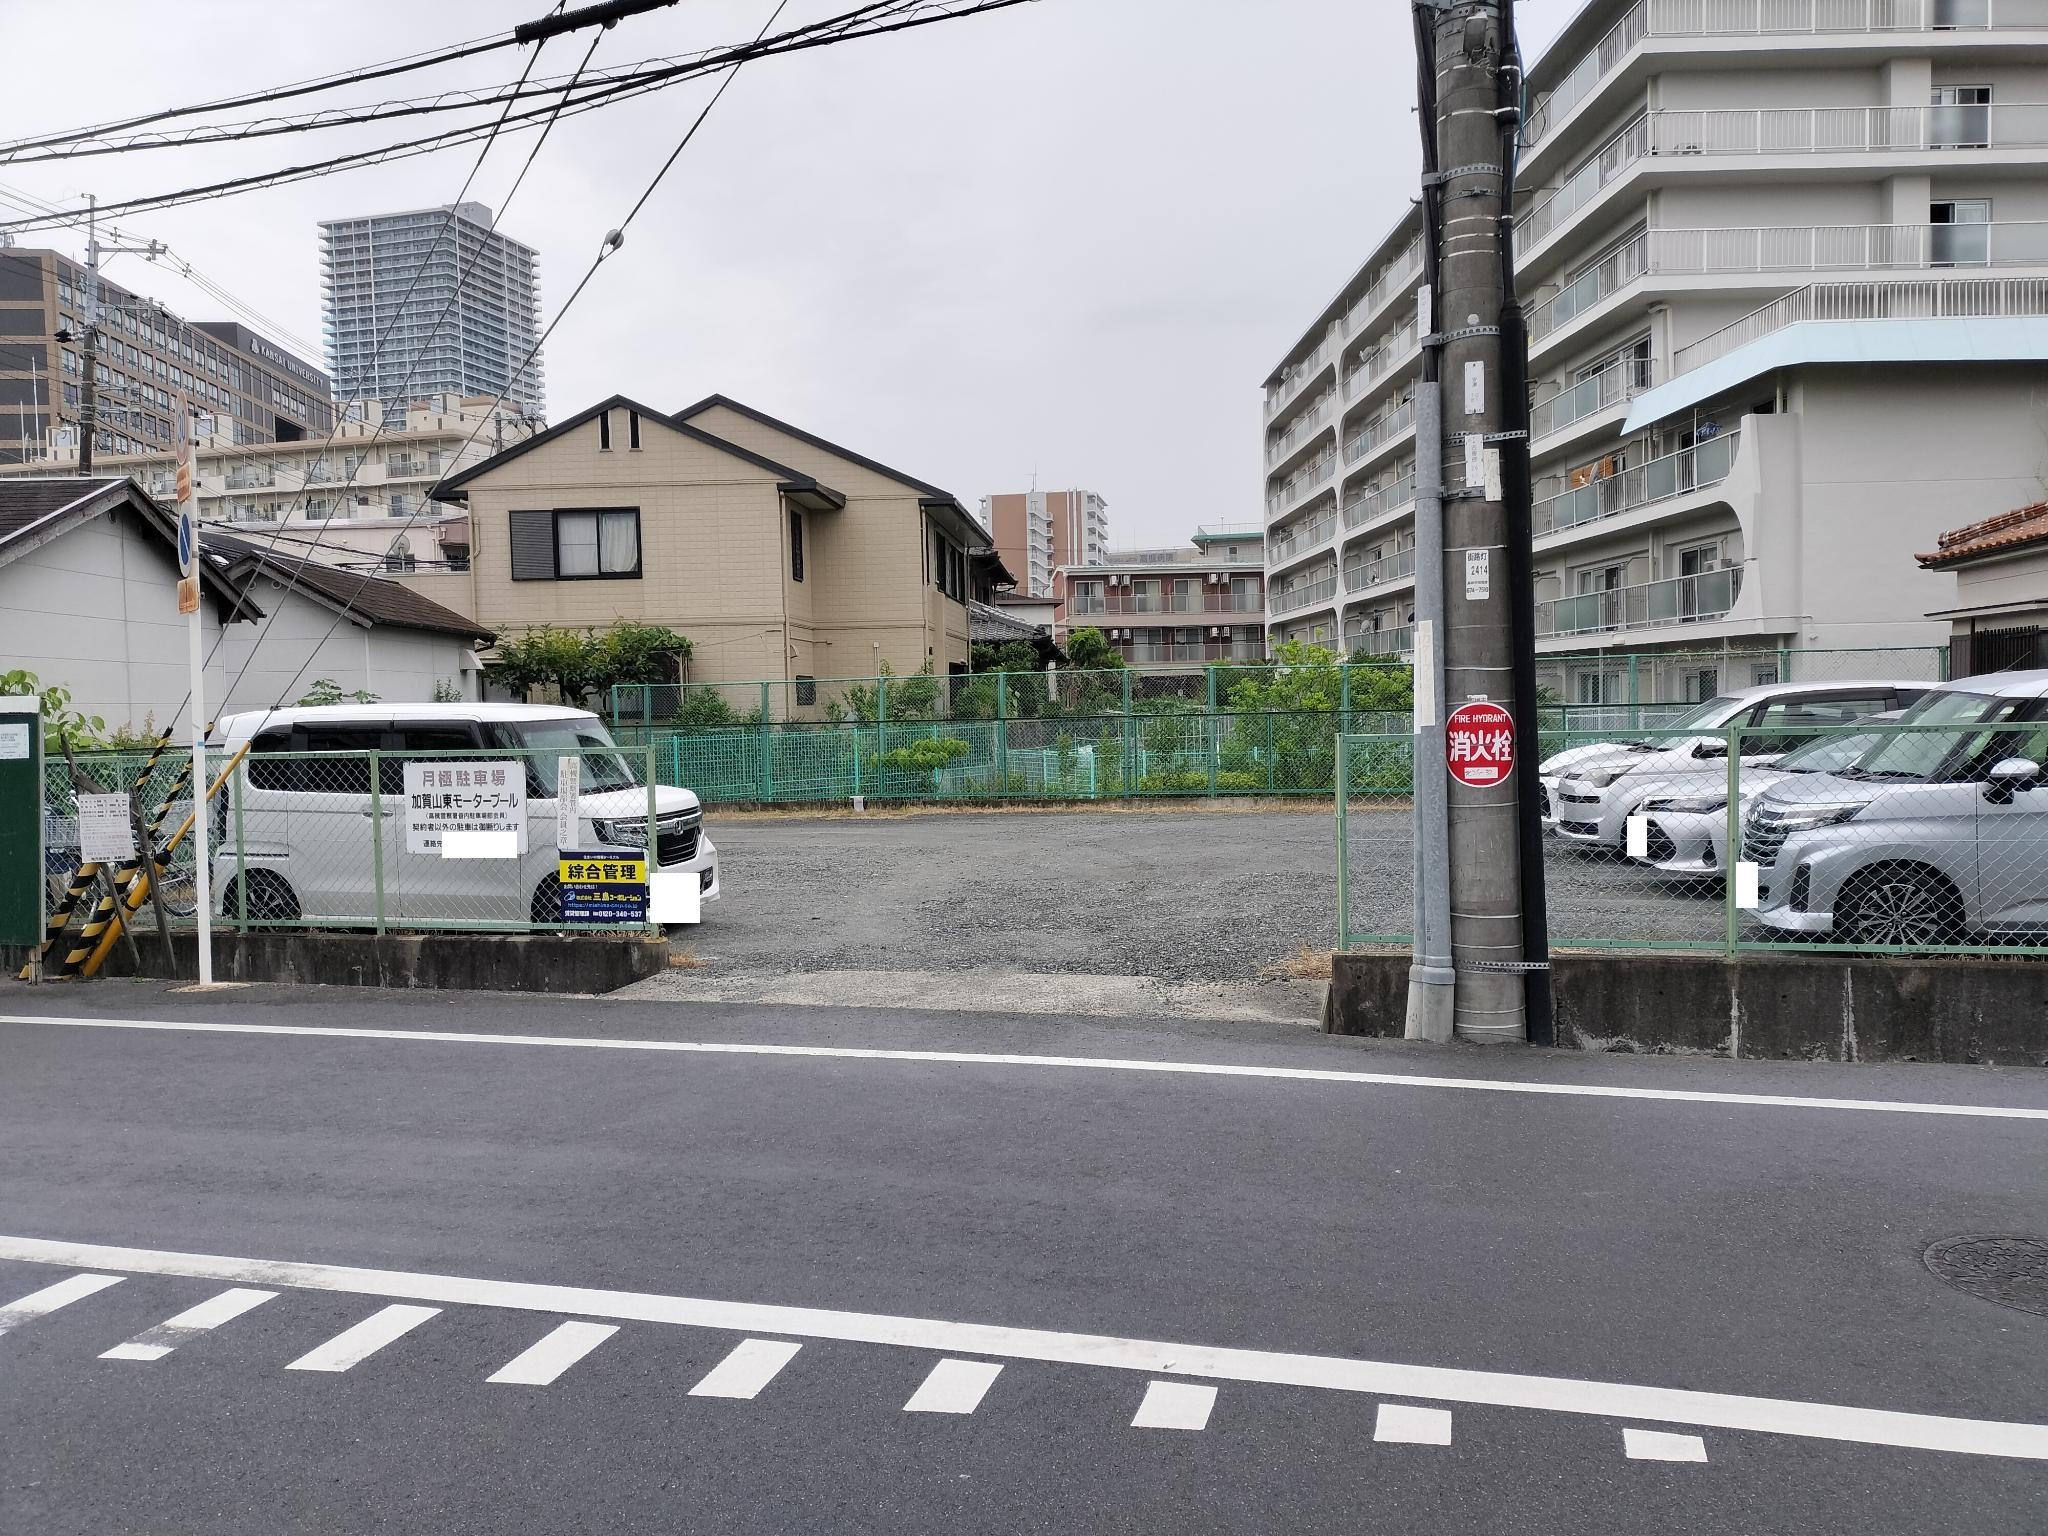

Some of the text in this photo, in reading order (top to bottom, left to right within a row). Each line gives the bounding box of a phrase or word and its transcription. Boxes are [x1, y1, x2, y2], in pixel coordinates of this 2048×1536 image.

[261, 345, 323, 388] KANSAI UNIVERSITY
[1454, 713, 1507, 724] FIRE HYDRANT
[1448, 729, 1512, 761] 消火栓
[422, 769, 506, 787] 月極駐車場
[411, 793, 519, 810] 加賀山東モータープール
[412, 822, 520, 832] 契約者以外の駐車は御断りします
[567, 863, 637, 880] 綜合管理
